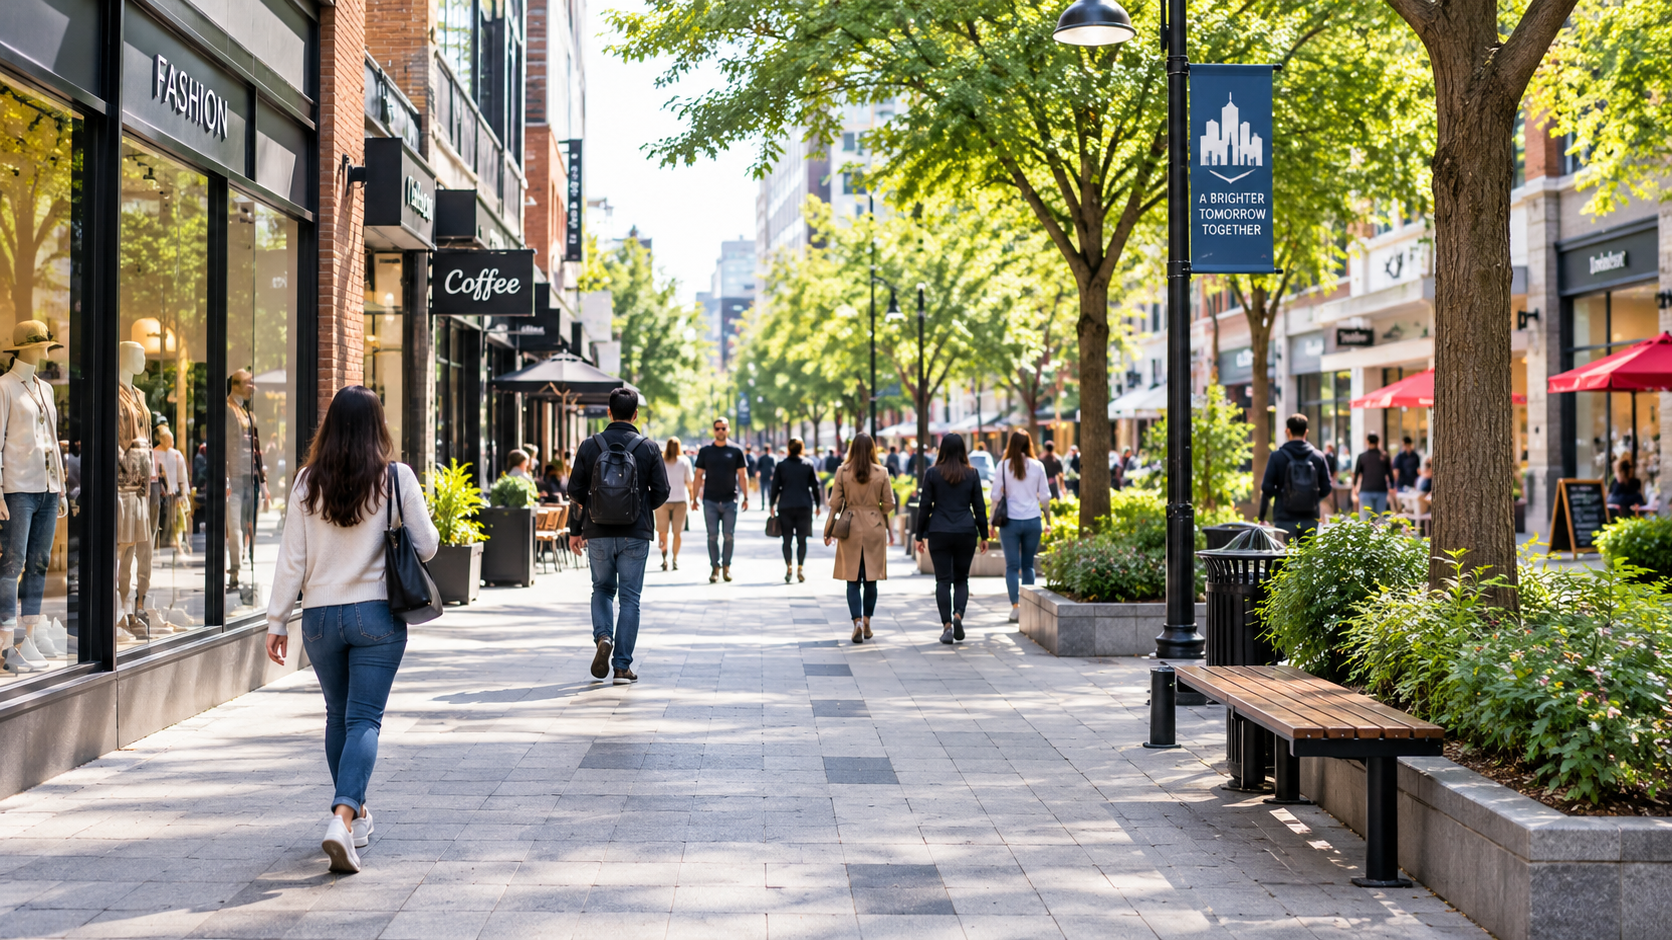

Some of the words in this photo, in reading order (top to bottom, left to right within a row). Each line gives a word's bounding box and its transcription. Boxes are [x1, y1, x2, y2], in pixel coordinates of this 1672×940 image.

[156, 53, 228, 139] FASHION
[1199, 193, 1207, 204] A
[1210, 192, 1265, 205] BRIGHTER
[1199, 208, 1266, 220] TOMORROW
[1202, 224, 1262, 236] TOGETHER
[444, 268, 521, 301] Coffee
